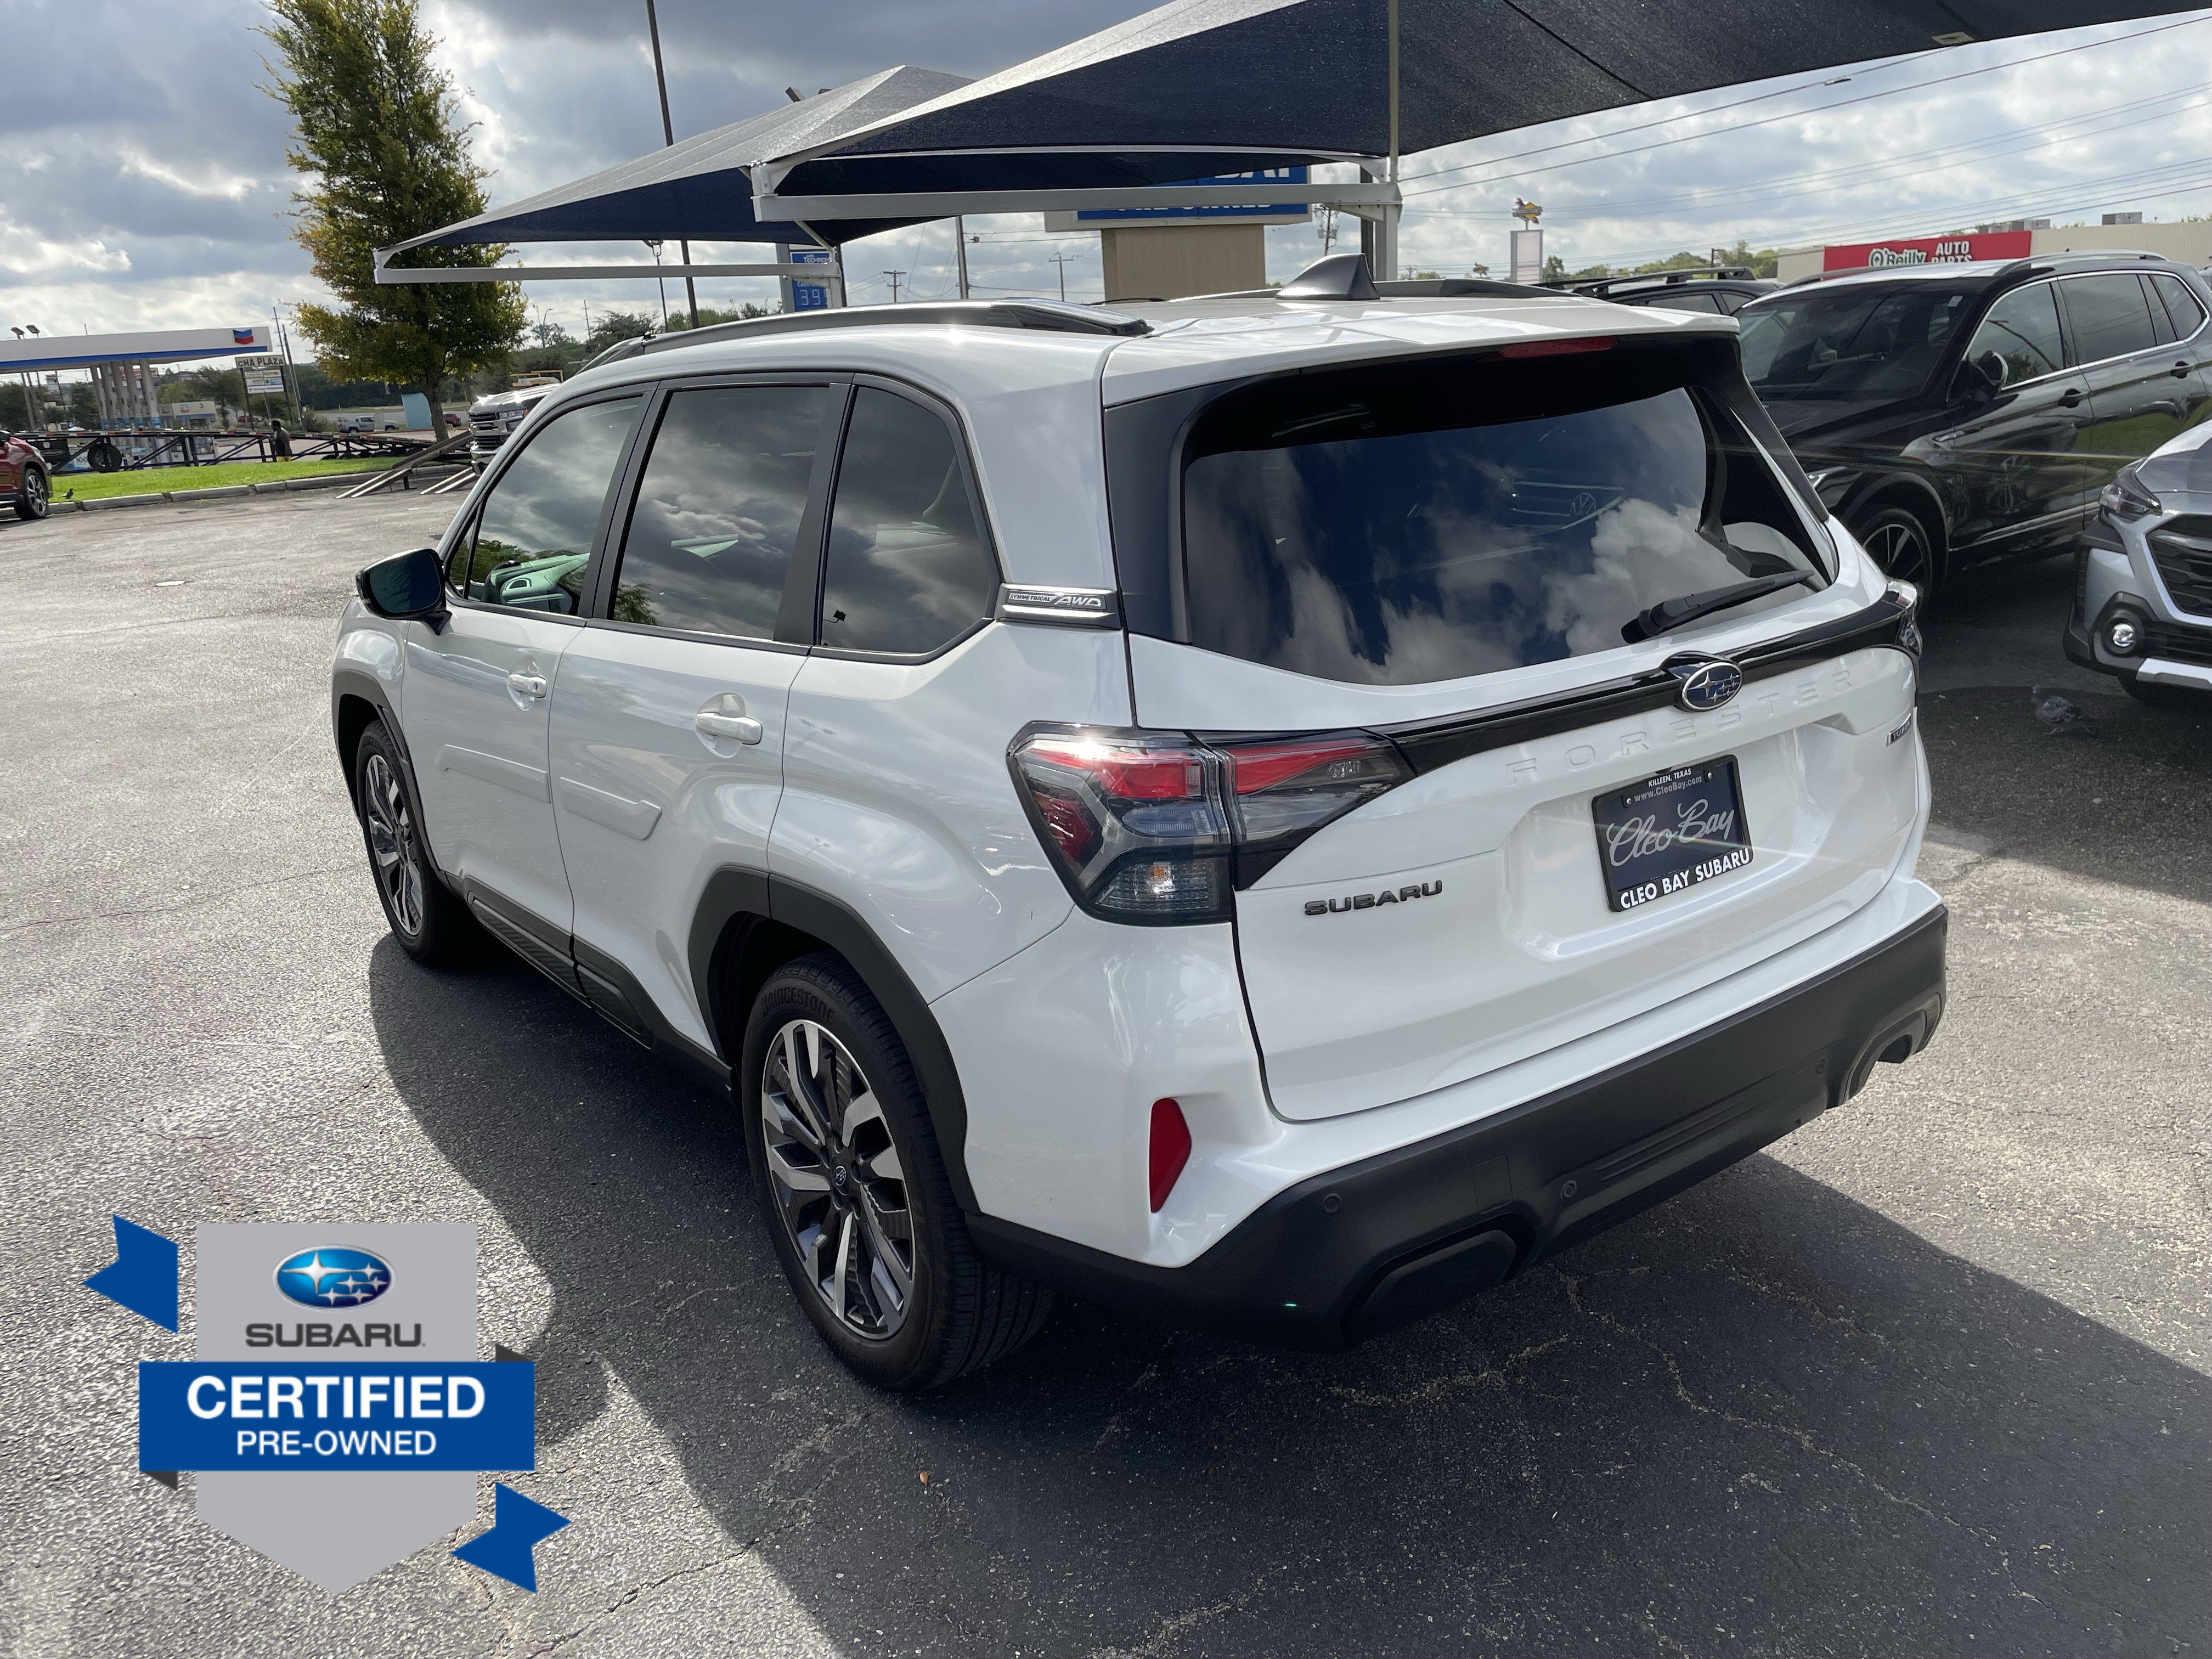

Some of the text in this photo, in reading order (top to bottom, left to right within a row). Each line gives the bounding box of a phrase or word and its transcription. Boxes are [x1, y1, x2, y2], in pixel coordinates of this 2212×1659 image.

[1868, 247, 1928, 268] O'Reilly
[1935, 241, 1970, 256] AUTO
[238, 357, 284, 367] CHA PLAZA
[1009, 594, 1102, 608] SYMMETRICAL AWD
[1506, 670, 1855, 787] FORESTER
[1634, 775, 1702, 803] www.CleoBay.com
[1647, 768, 1692, 788] KILLEEN, TEXAS
[1606, 798, 1735, 867] Cleo Bay
[1620, 882, 1657, 909] CLEO
[1662, 870, 1690, 895] BAY
[1695, 847, 1750, 882] SUBARU
[1305, 879, 1443, 916] SUBARU
